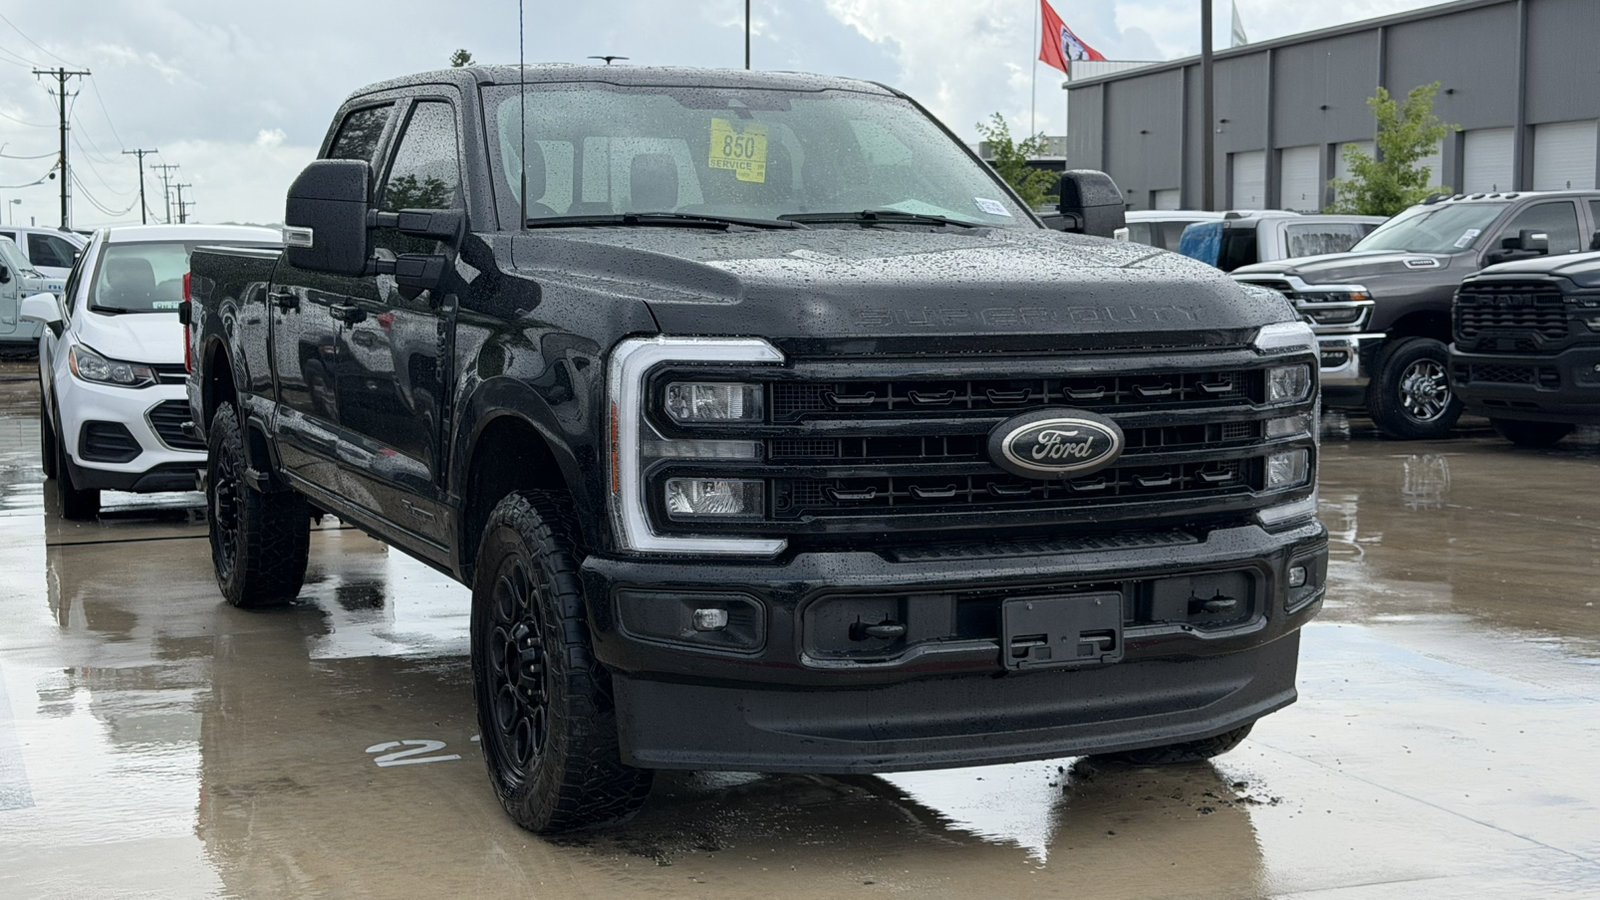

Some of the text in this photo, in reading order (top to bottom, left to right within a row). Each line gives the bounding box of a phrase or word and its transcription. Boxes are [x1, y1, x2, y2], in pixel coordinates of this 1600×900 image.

[723, 135, 755, 159] 850
[710, 159, 753, 171] SERVICE
[1475, 293, 1533, 306] RAM
[854, 303, 1203, 326] SUPER DUTY
[1031, 429, 1094, 460] Ford
[365, 735, 481, 768] 2
